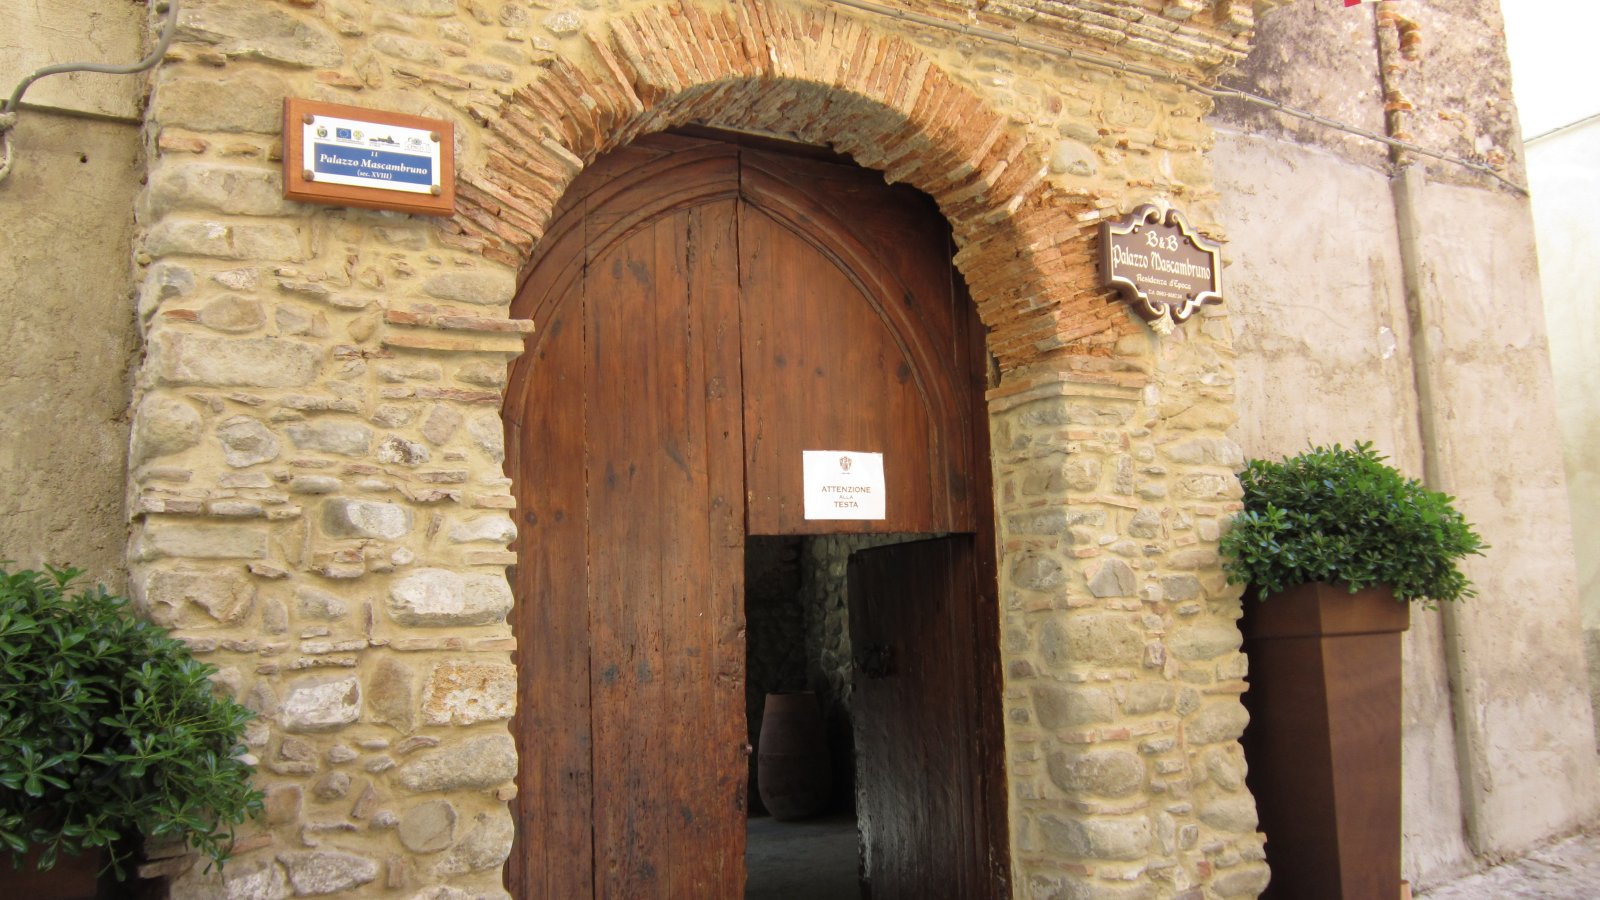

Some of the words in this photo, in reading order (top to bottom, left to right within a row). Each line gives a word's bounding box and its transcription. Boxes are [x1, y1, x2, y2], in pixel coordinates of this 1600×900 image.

[320, 153, 359, 167] Palazzo
[360, 158, 428, 175] Mascambruno
[357, 169, 370, 177] (sec.
[371, 171, 392, 180] XVIII)
[1145, 230, 1179, 251] B&B
[1112, 244, 1149, 268] Palazzo
[1151, 251, 1211, 280] Mascambruno
[1136, 273, 1167, 286] Residenza
[821, 485, 871, 493] ATTENZIONE
